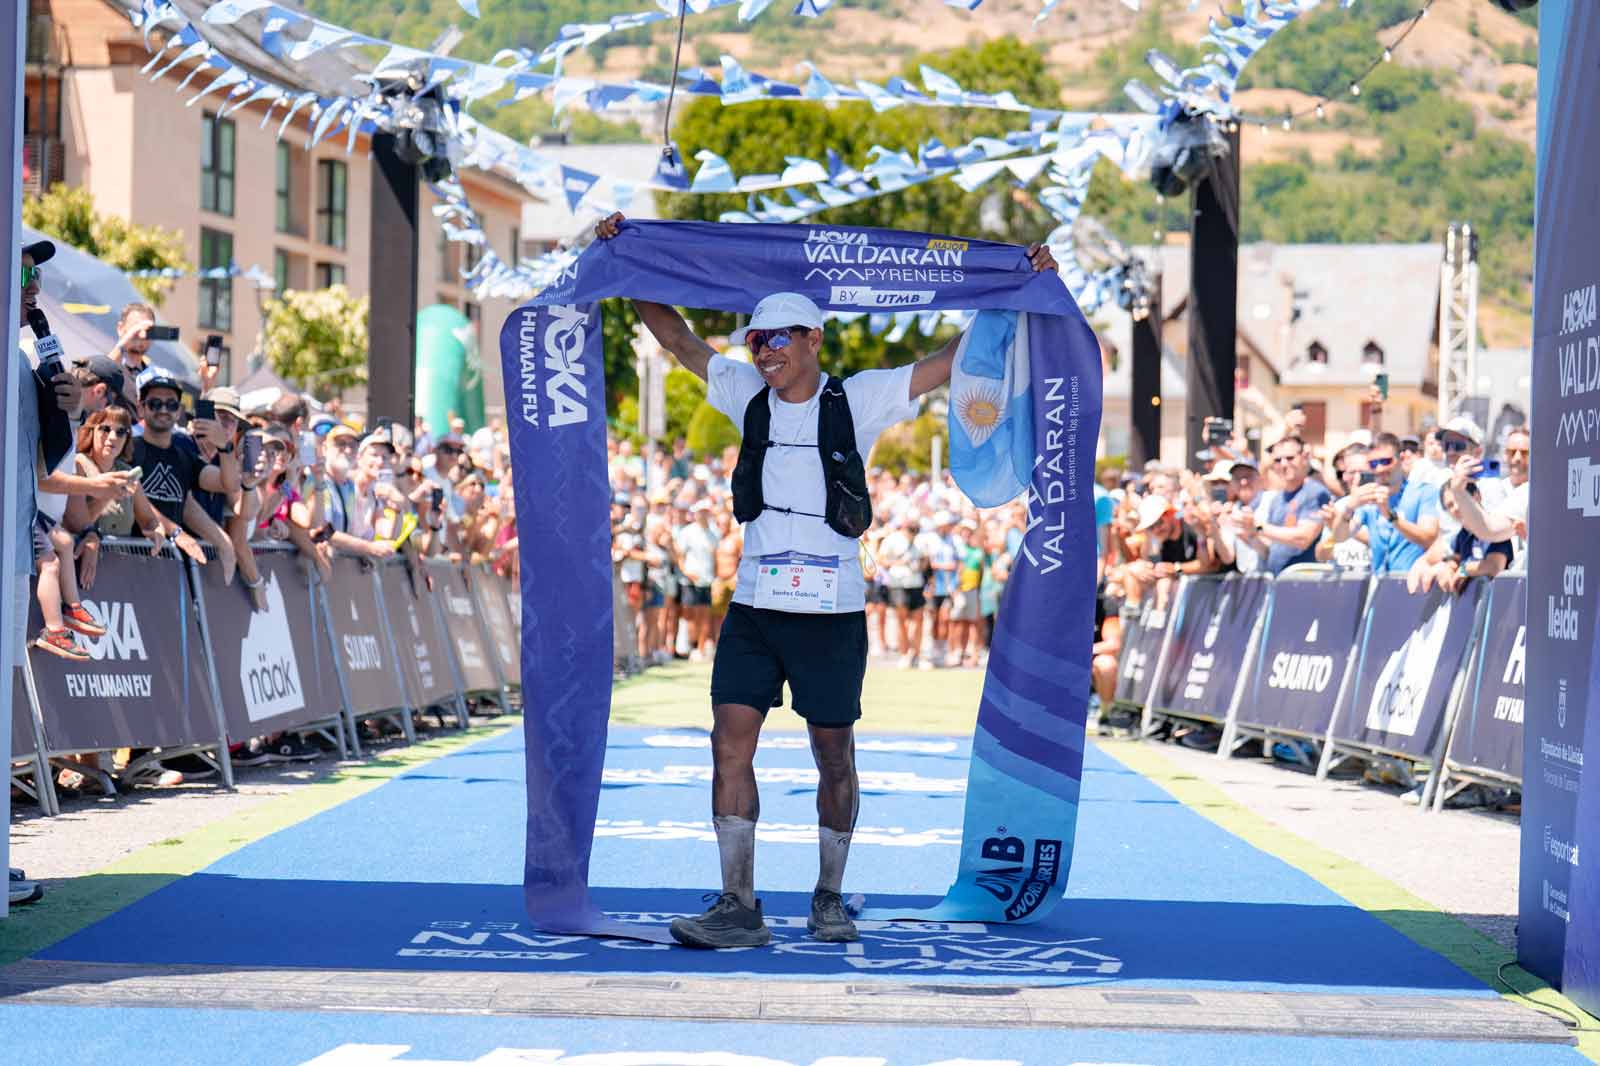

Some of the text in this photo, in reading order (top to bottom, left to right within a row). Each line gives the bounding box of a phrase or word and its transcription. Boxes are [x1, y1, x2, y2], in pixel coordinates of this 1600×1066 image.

[806, 229, 869, 246] HOKA
[864, 268, 964, 282] PYRENEES
[839, 290, 921, 305] BY UTMB
[1561, 284, 1598, 333] HOKA
[519, 311, 539, 427] HUMAN FLY
[1040, 377, 1065, 575] VAL D'ARAN
[1571, 468, 1583, 499] BY
[791, 575, 801, 588] 5
[1563, 565, 1584, 595] ara
[1548, 595, 1578, 641] lleida
[65, 673, 152, 698] FLY HUMAN FLY
[1268, 652, 1334, 693] SUUNTO
[877, 922, 950, 932] BY
[842, 956, 1124, 974] HOKA
